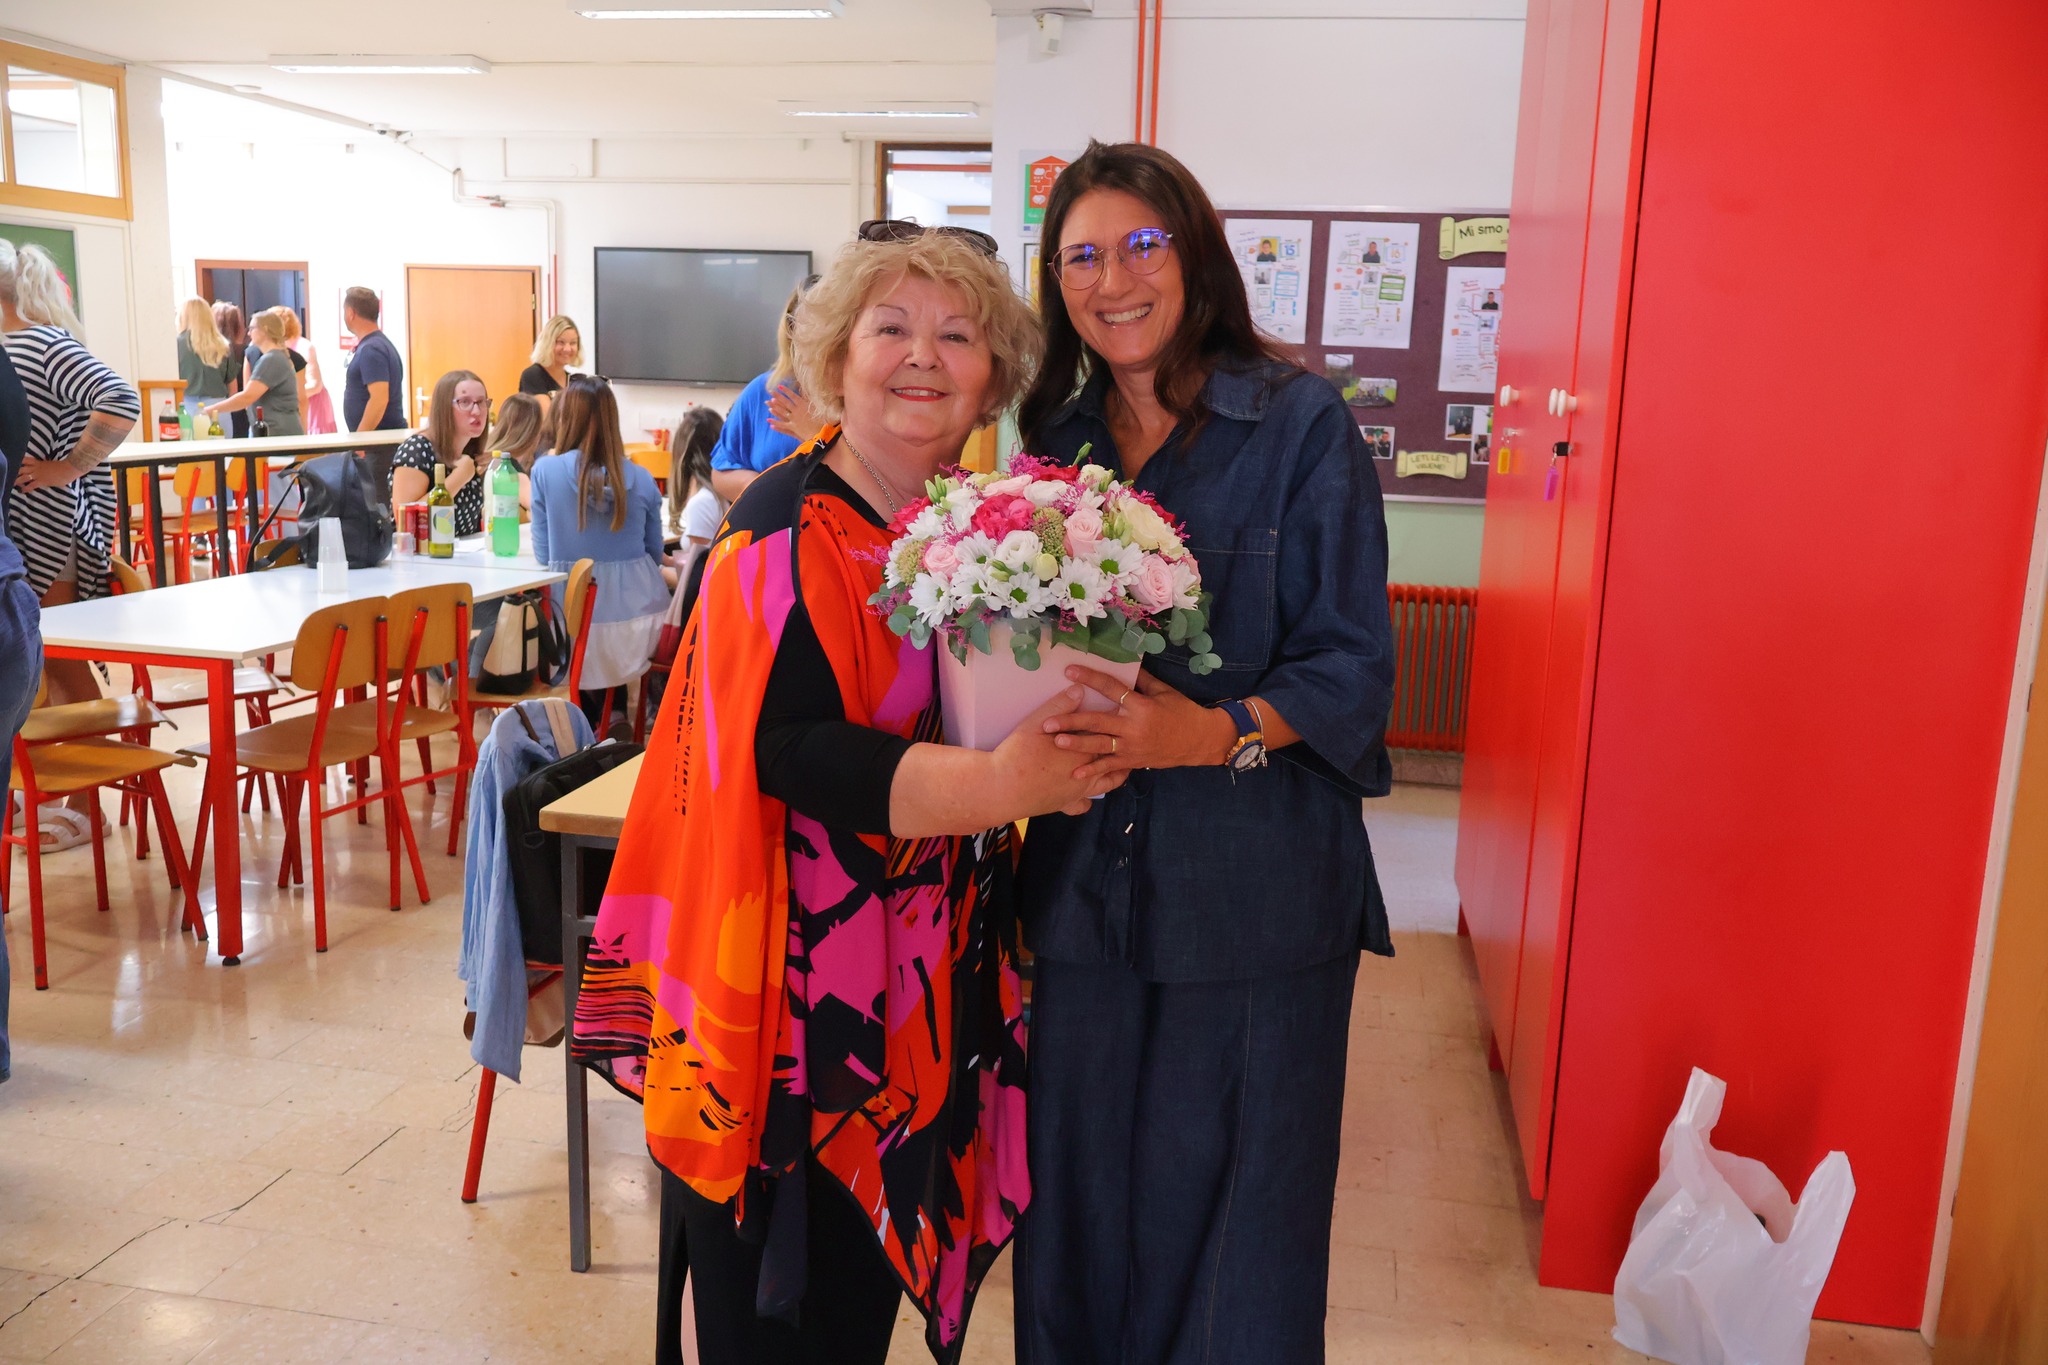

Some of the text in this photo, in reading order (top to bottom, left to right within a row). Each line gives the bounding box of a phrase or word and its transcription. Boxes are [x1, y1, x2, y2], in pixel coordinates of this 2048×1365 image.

[1459, 226, 1475, 239] Mi
[1478, 225, 1503, 235] smo
[1284, 244, 1295, 256] 15
